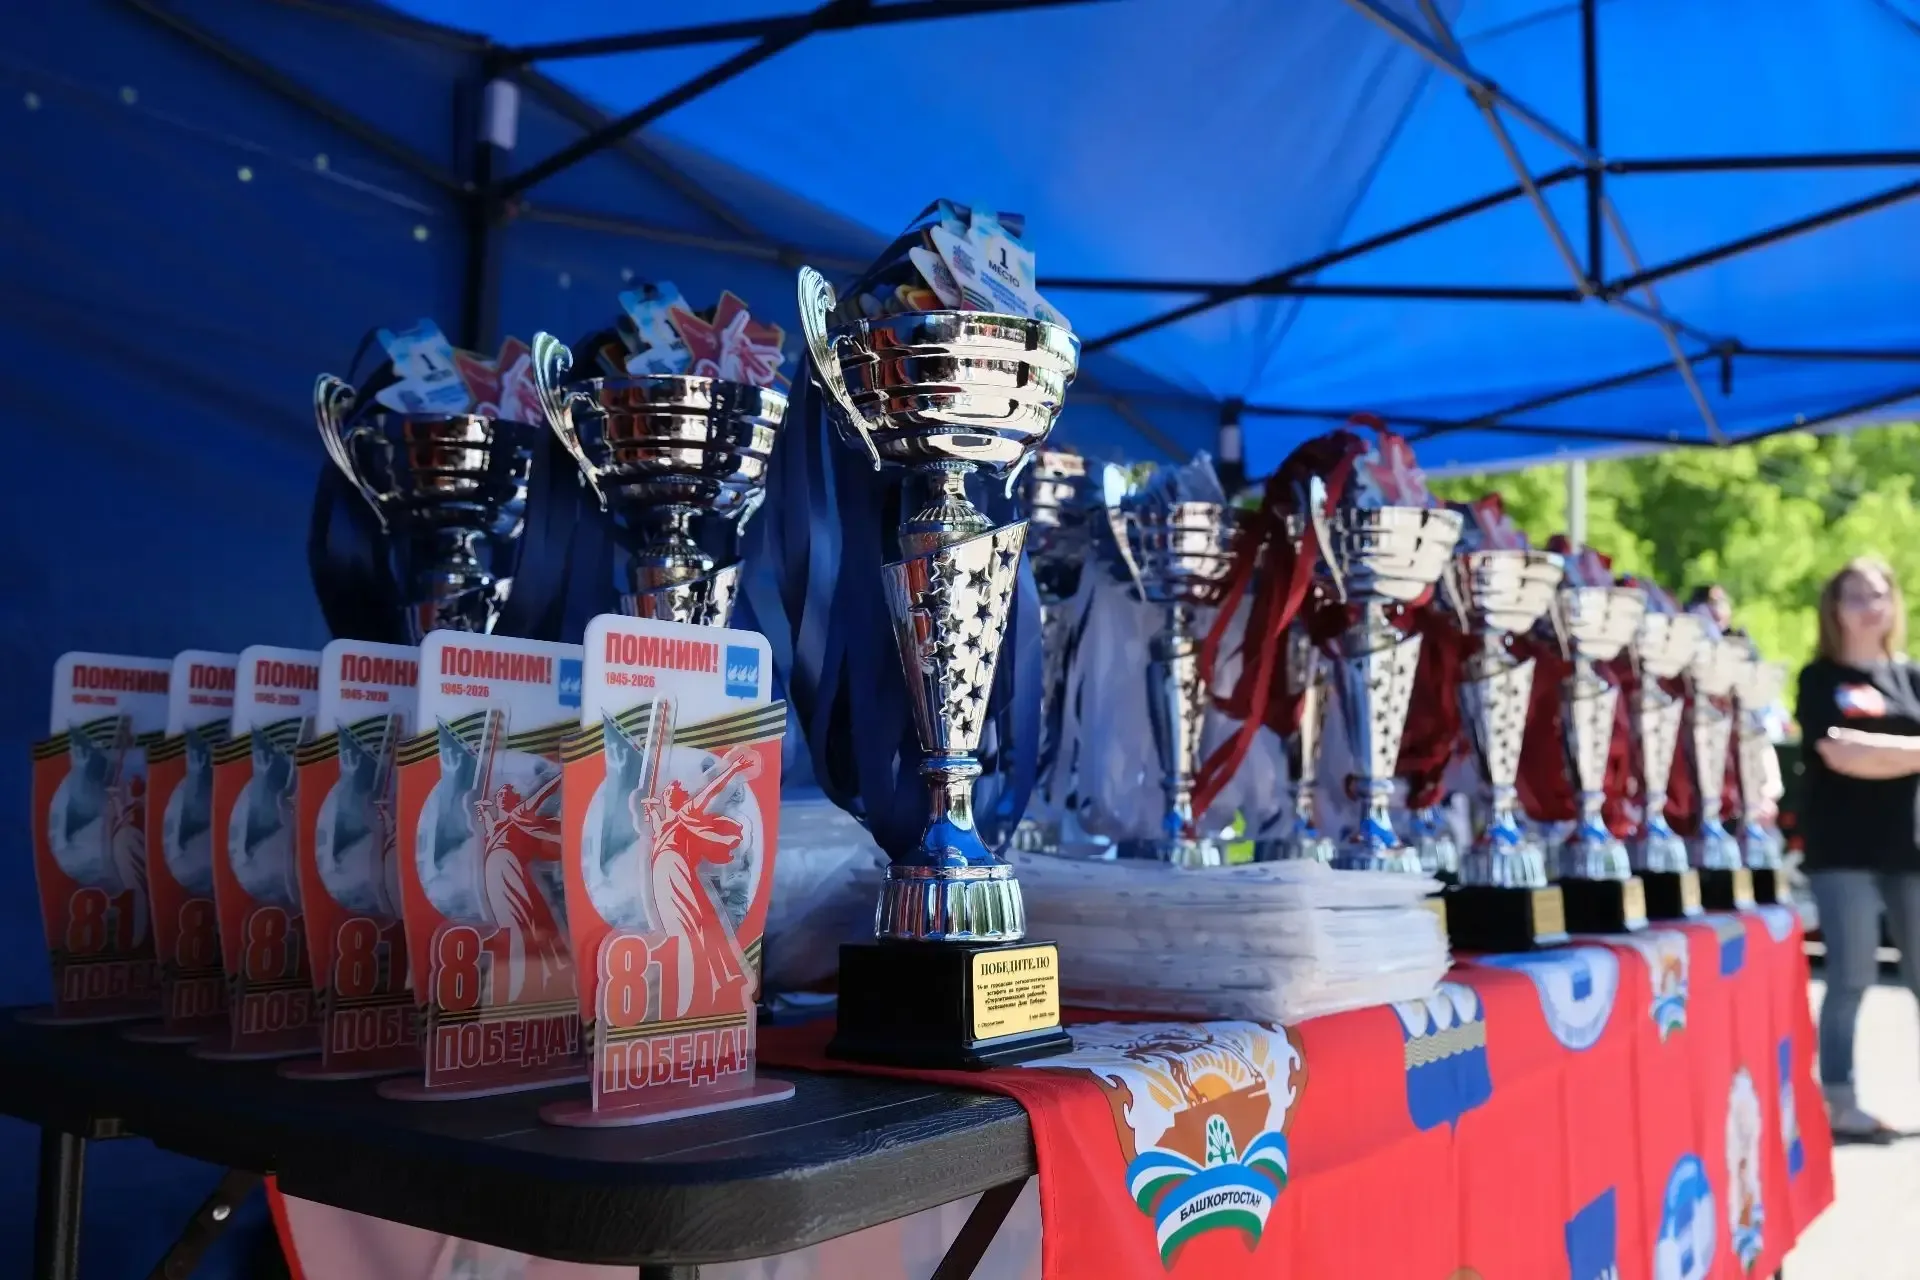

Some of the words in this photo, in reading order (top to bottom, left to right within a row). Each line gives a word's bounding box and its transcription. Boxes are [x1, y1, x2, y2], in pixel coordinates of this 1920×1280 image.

[988, 259, 1020, 288] МЕСТО
[1000, 247, 1008, 269] 1
[340, 653, 419, 688] ПОМНИ
[440, 646, 552, 685] ПОМНИМ!
[605, 631, 719, 674] ПОМНИМ!
[72, 664, 169, 695] ПОМНИМ
[255, 659, 319, 691] ПОМН
[440, 682, 490, 698] 1945-2026
[604, 671, 656, 689] 1945-2026
[67, 888, 136, 954] 81
[178, 899, 217, 970] 8
[337, 918, 408, 997] 81
[438, 926, 511, 1011] 81
[981, 957, 1049, 975] ПОБЕДИТЕЛЮ
[605, 935, 681, 1028] 81
[334, 1006, 419, 1054] ПОБЕ
[436, 1014, 579, 1071] ПОБЕДА!
[603, 1028, 747, 1093] ПОБЕДА!
